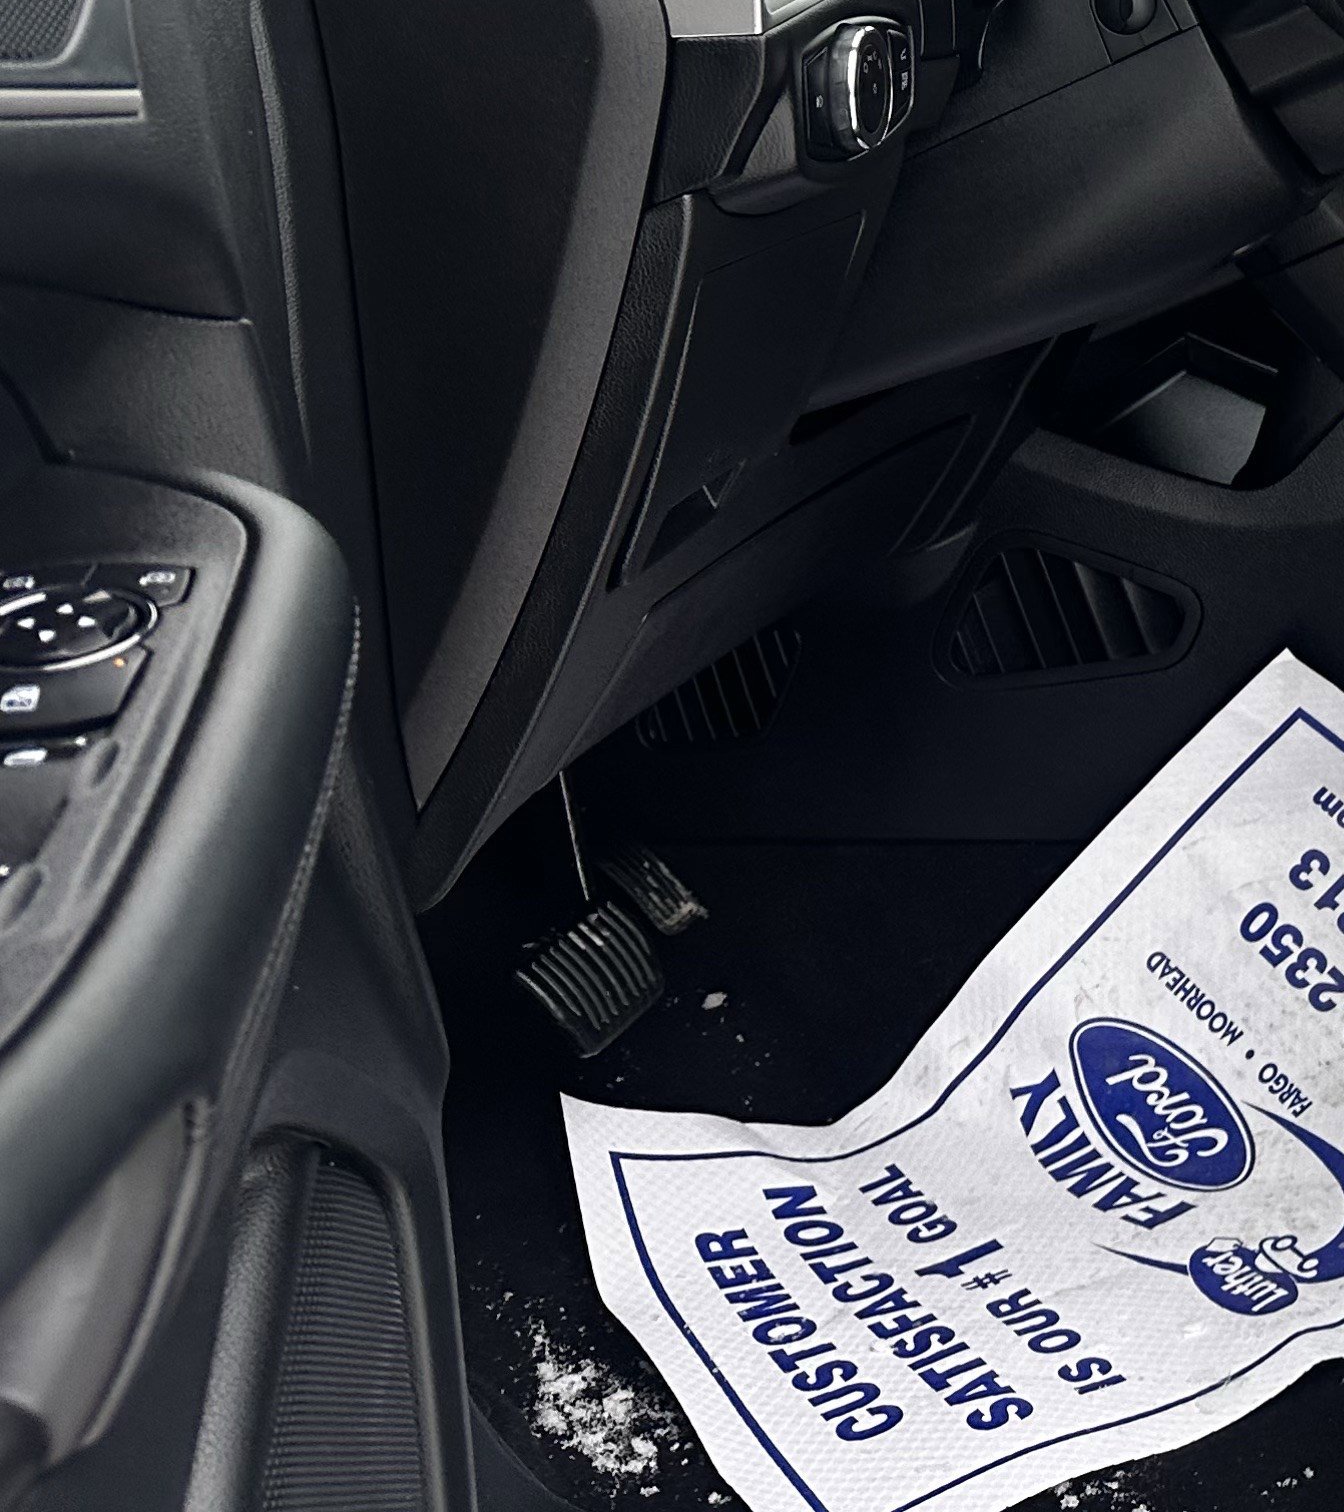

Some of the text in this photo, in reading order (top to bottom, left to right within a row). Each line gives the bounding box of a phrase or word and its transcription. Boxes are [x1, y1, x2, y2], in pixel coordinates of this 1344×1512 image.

[1106, 1053, 1229, 1168] Ford
[1147, 952, 1313, 1118] FARGO MOORHEAD
[1010, 1069, 1196, 1230] FAMILY
[695, 1229, 903, 1441] CUSTOMER
[763, 1186, 1033, 1430] SATISFACTION
[859, 1164, 1126, 1394] IS OUR #1 GOAL
[1202, 1251, 1289, 1312] Luther
